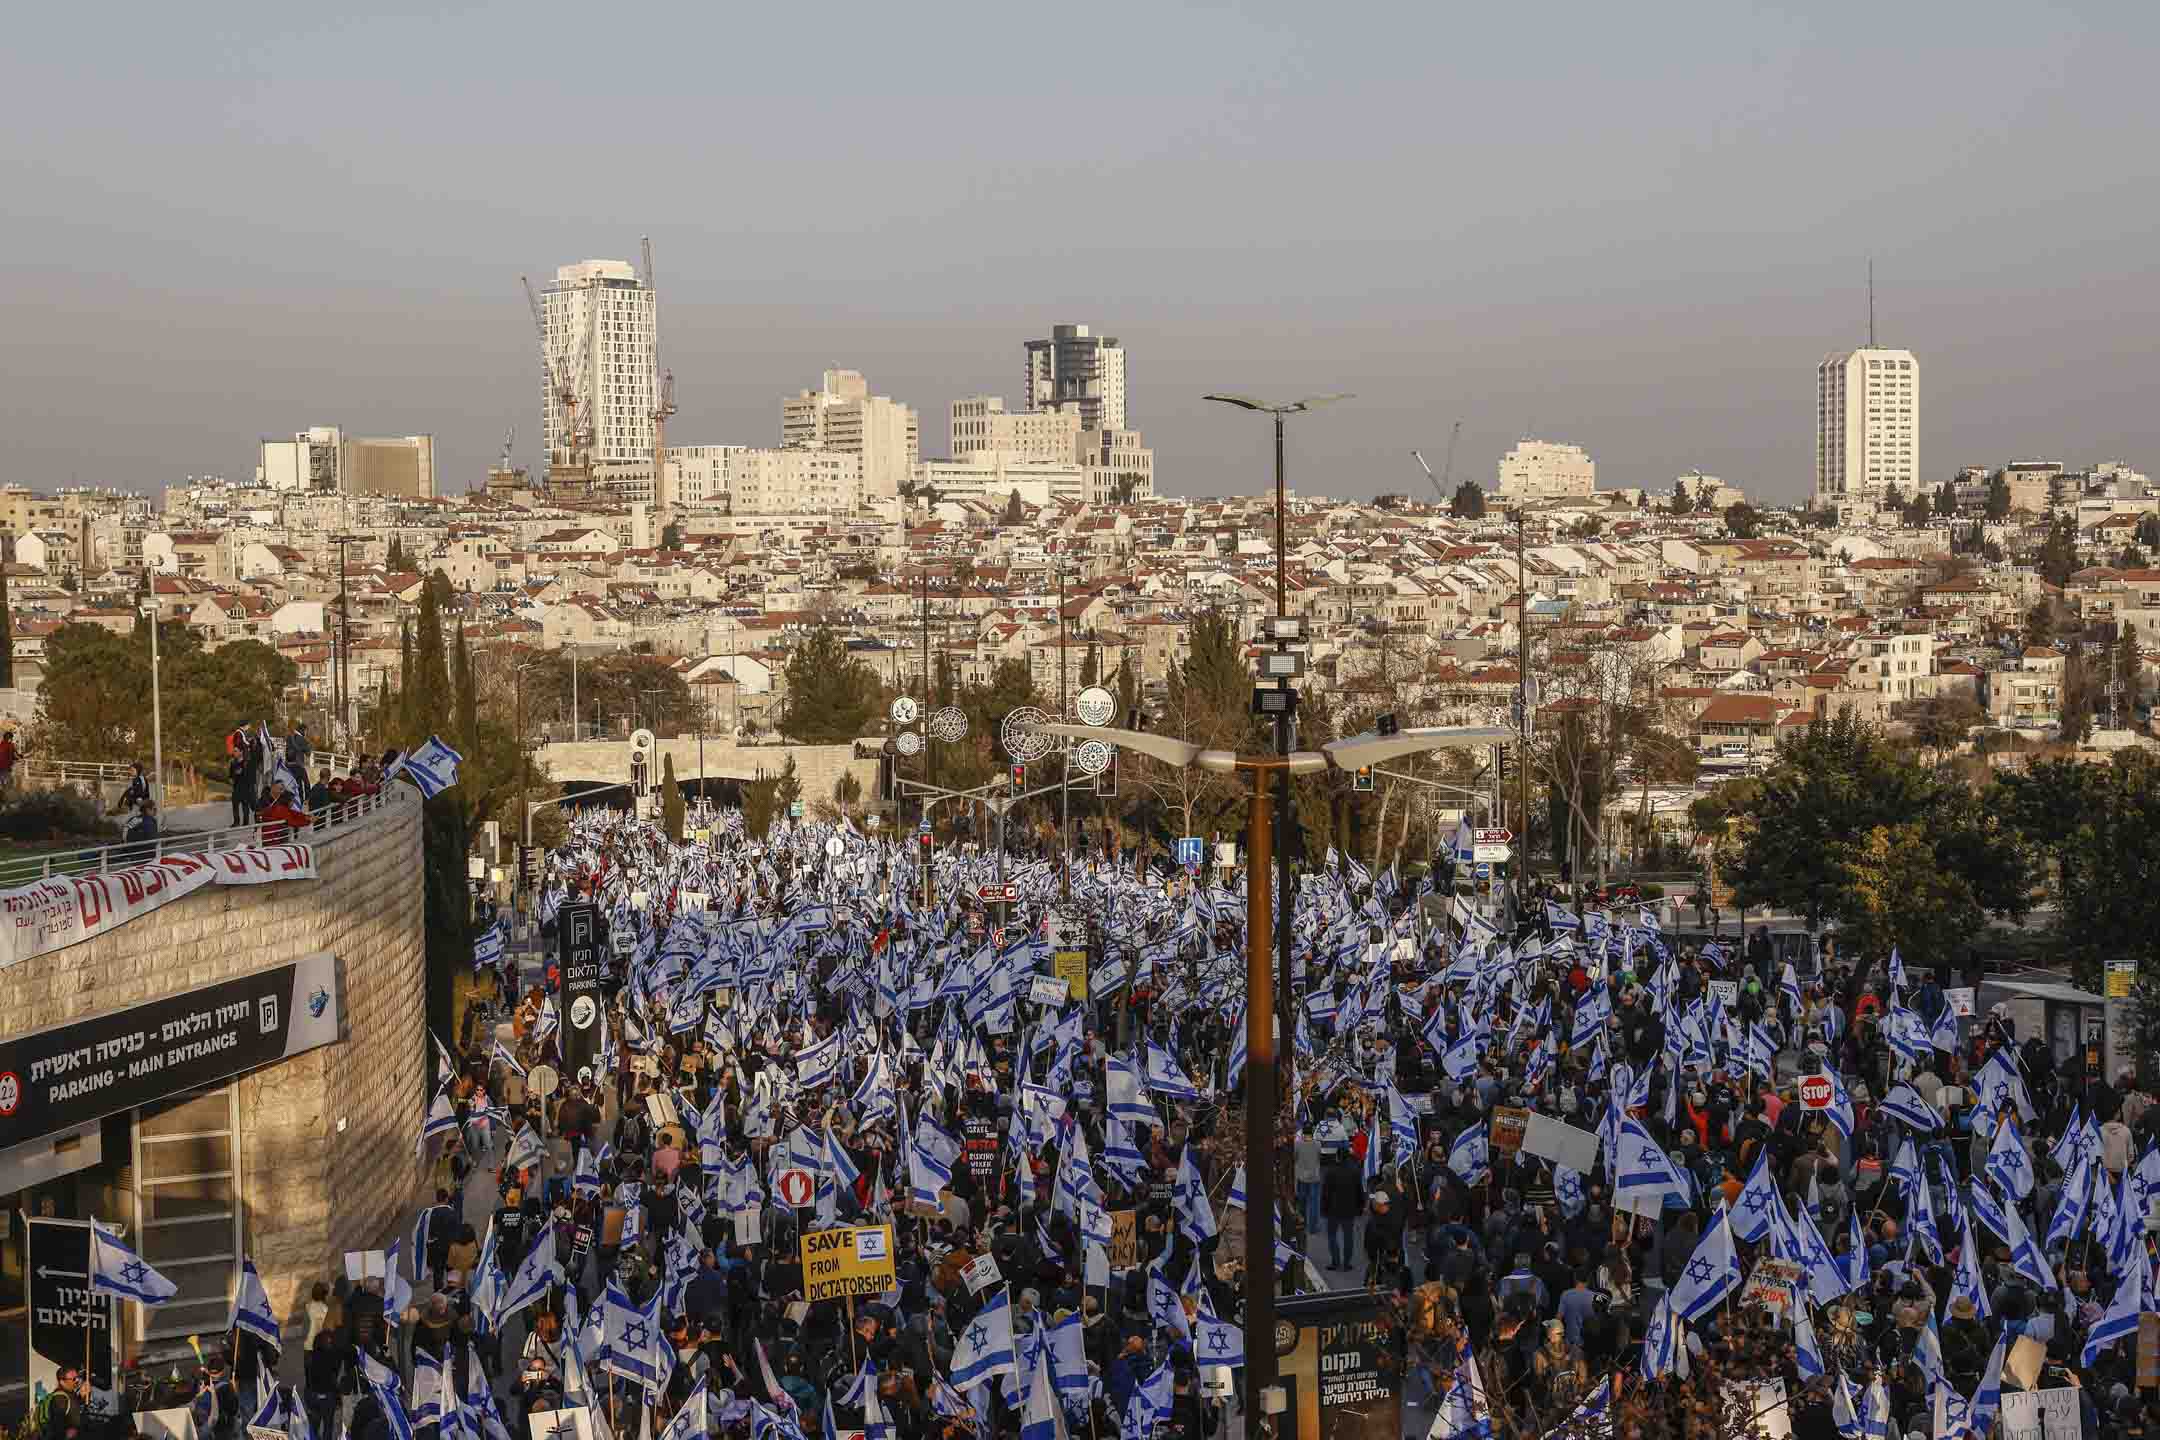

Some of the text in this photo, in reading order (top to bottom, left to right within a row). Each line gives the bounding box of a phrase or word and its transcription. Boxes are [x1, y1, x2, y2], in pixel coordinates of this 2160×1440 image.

[572, 948, 592, 967] חניון
[567, 962, 598, 979] הלאום
[568, 979, 597, 991] PARKING
[215, 1000, 249, 1029] חניון
[161, 1011, 211, 1042] הלאום
[95, 1031, 145, 1062] כניסה
[30, 1048, 91, 1083] ראשית
[49, 1069, 114, 1104] PARKING
[128, 1053, 163, 1079] MAIN
[167, 1031, 238, 1067] ENTRANCE
[1802, 1084, 1831, 1100] STOP
[807, 1230, 854, 1254] SAVE
[810, 1258, 840, 1277] FROM
[809, 1273, 893, 1300] DICTATORSHIP
[36, 1307, 106, 1329] הלאום
[1321, 1351, 1361, 1373] מקום
[1322, 1379, 1377, 1395] בהסרת שיער
[1323, 1387, 1390, 1405] בלייזר בירושלים
